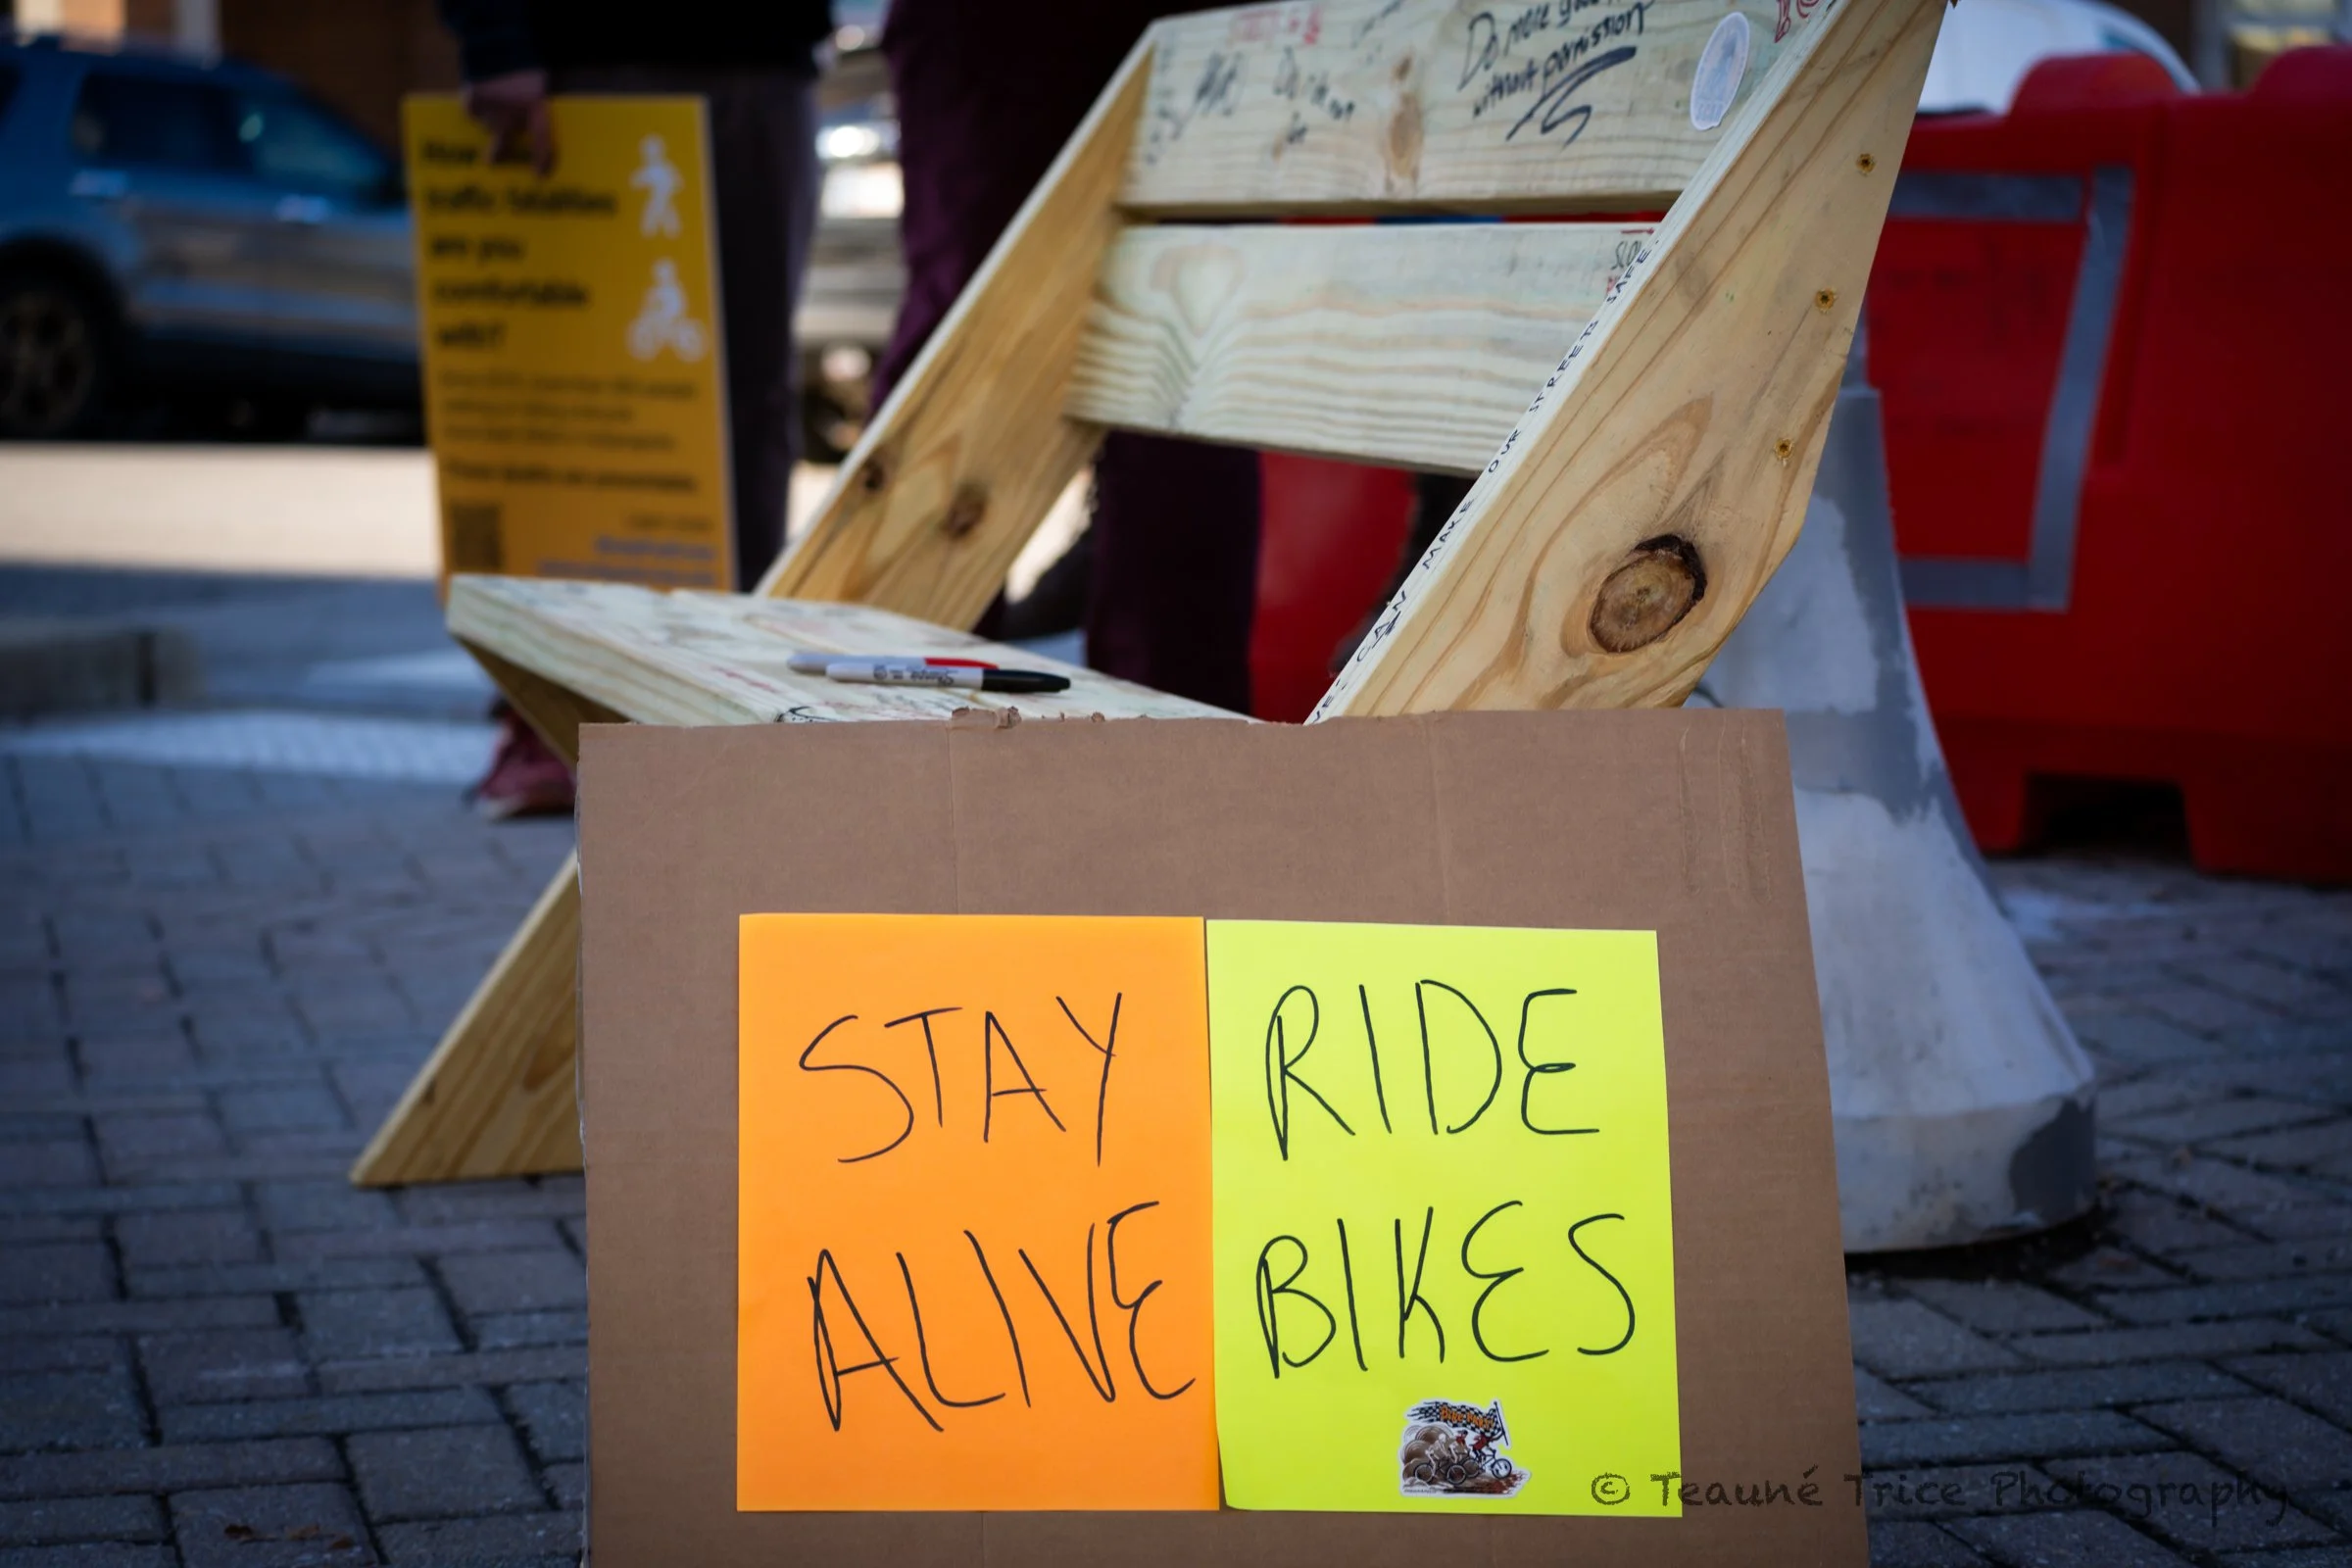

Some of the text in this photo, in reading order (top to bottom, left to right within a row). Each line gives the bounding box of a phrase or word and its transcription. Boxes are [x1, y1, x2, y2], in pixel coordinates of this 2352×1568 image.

[1356, 589, 1407, 662] CAN
[1422, 498, 1475, 568] MAKE
[1488, 428, 1521, 473] OUR
[1529, 319, 1599, 413] STREETS
[800, 993, 1124, 1167] STAY
[1265, 979, 1599, 1161] RIDE
[807, 1200, 1196, 1432] ALIVE
[1255, 1200, 1636, 1380] BIKES
